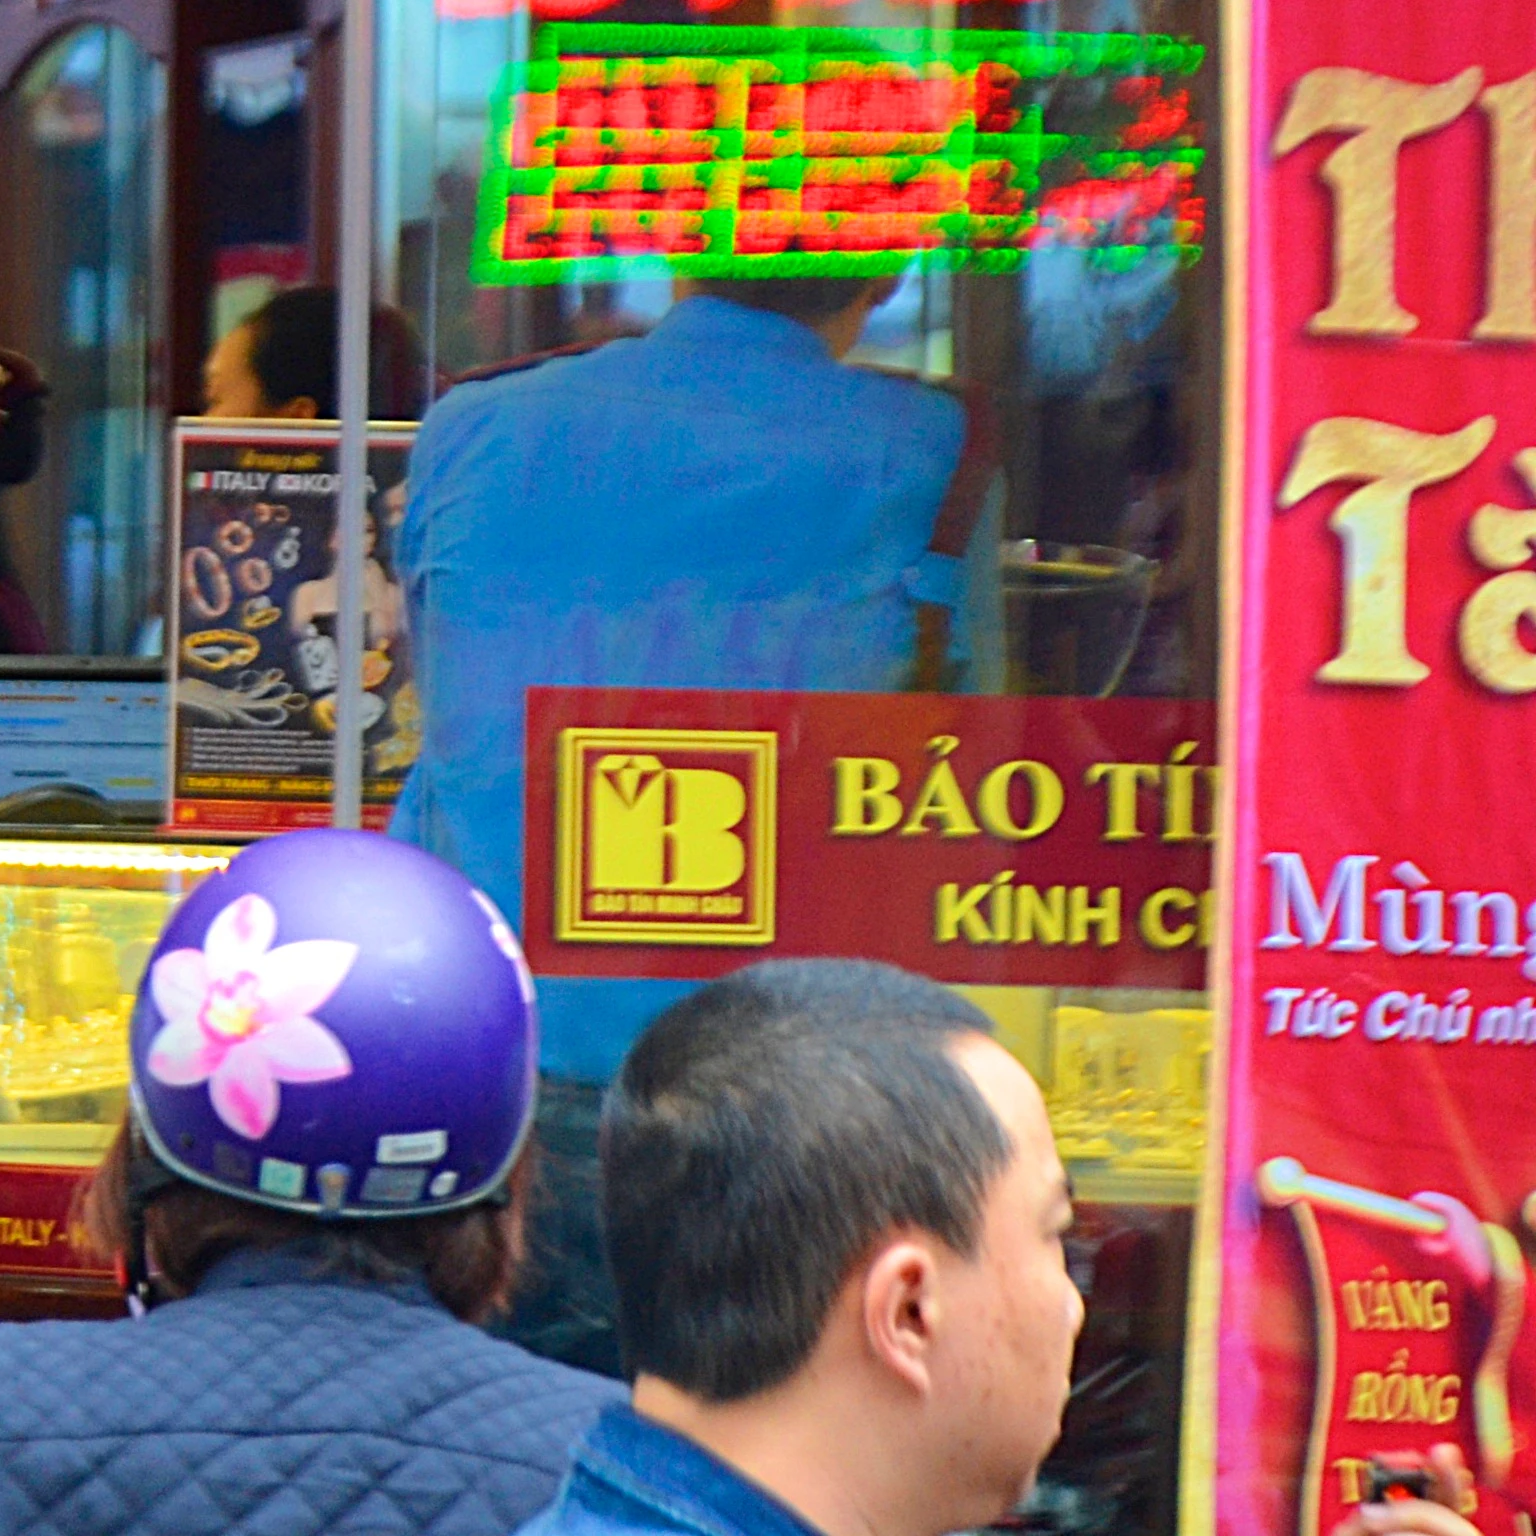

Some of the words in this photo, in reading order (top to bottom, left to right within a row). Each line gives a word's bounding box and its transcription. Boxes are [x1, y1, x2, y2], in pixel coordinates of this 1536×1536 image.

[302, 472, 378, 494] KOA
[831, 735, 1066, 842] BẢO
[934, 869, 1122, 947] KÍNH
[1263, 986, 1359, 1038] Tức
[1362, 986, 1473, 1044] Chủ
